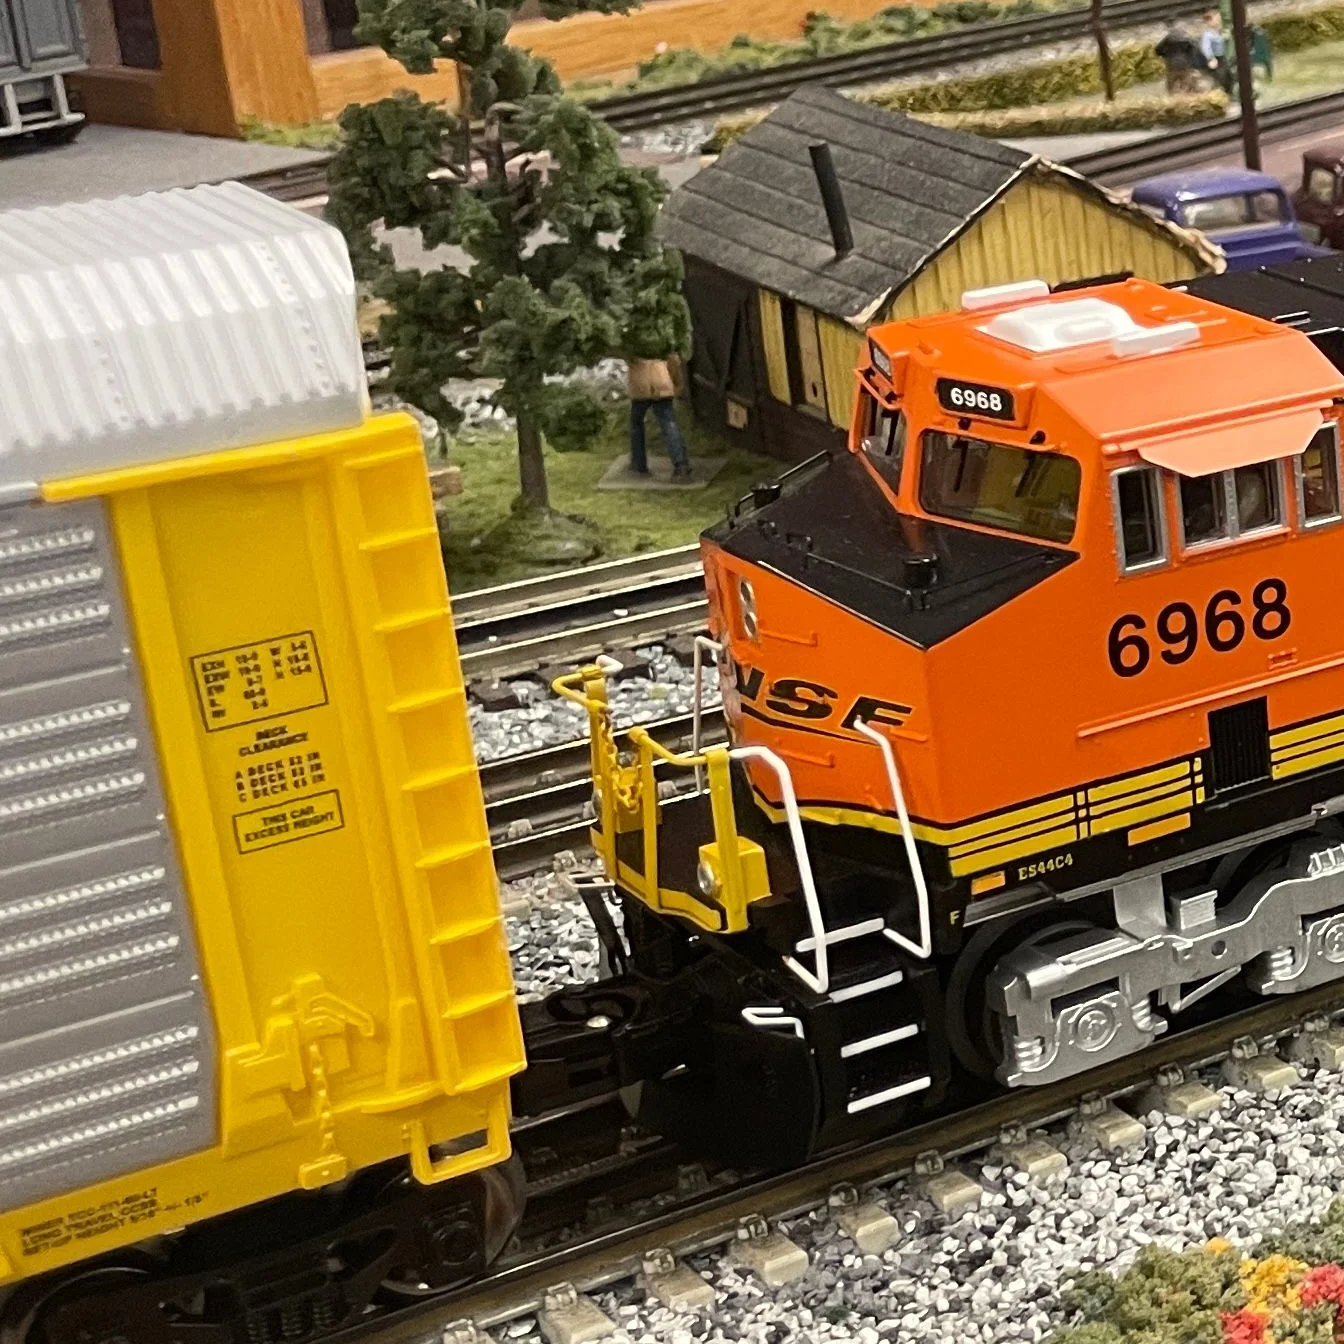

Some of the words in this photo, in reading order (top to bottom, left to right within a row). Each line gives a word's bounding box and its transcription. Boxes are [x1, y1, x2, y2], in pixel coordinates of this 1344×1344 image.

[950, 387, 1003, 412] 6968
[1107, 577, 1292, 679] 6968
[736, 661, 913, 731] NSF
[248, 760, 284, 777] DECK
[250, 772, 287, 789] DECK
[252, 782, 289, 800] DECK
[1017, 852, 1074, 881] ES44C4
[949, 909, 961, 925] F
